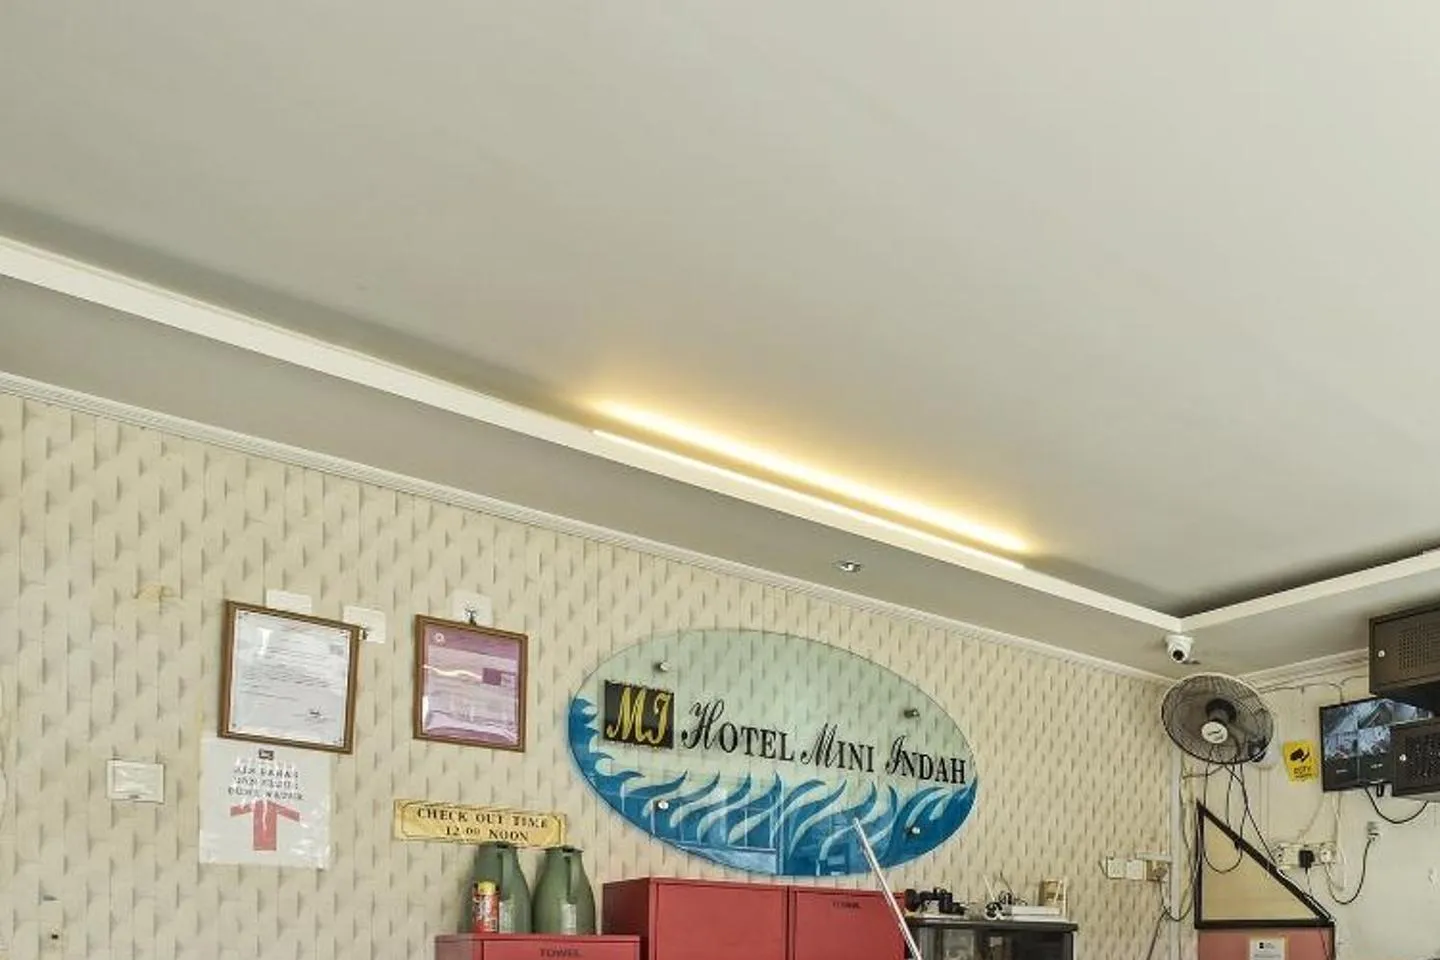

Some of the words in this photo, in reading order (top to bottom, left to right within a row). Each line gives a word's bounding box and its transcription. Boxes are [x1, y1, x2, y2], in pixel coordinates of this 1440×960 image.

[681, 700, 795, 762] HOTEL
[802, 722, 876, 772] MINI
[884, 734, 967, 785] INDAH
[417, 808, 468, 823] CHECK
[475, 812, 504, 825] OUT
[512, 815, 548, 829] TIME
[489, 829, 529, 842] NOON
